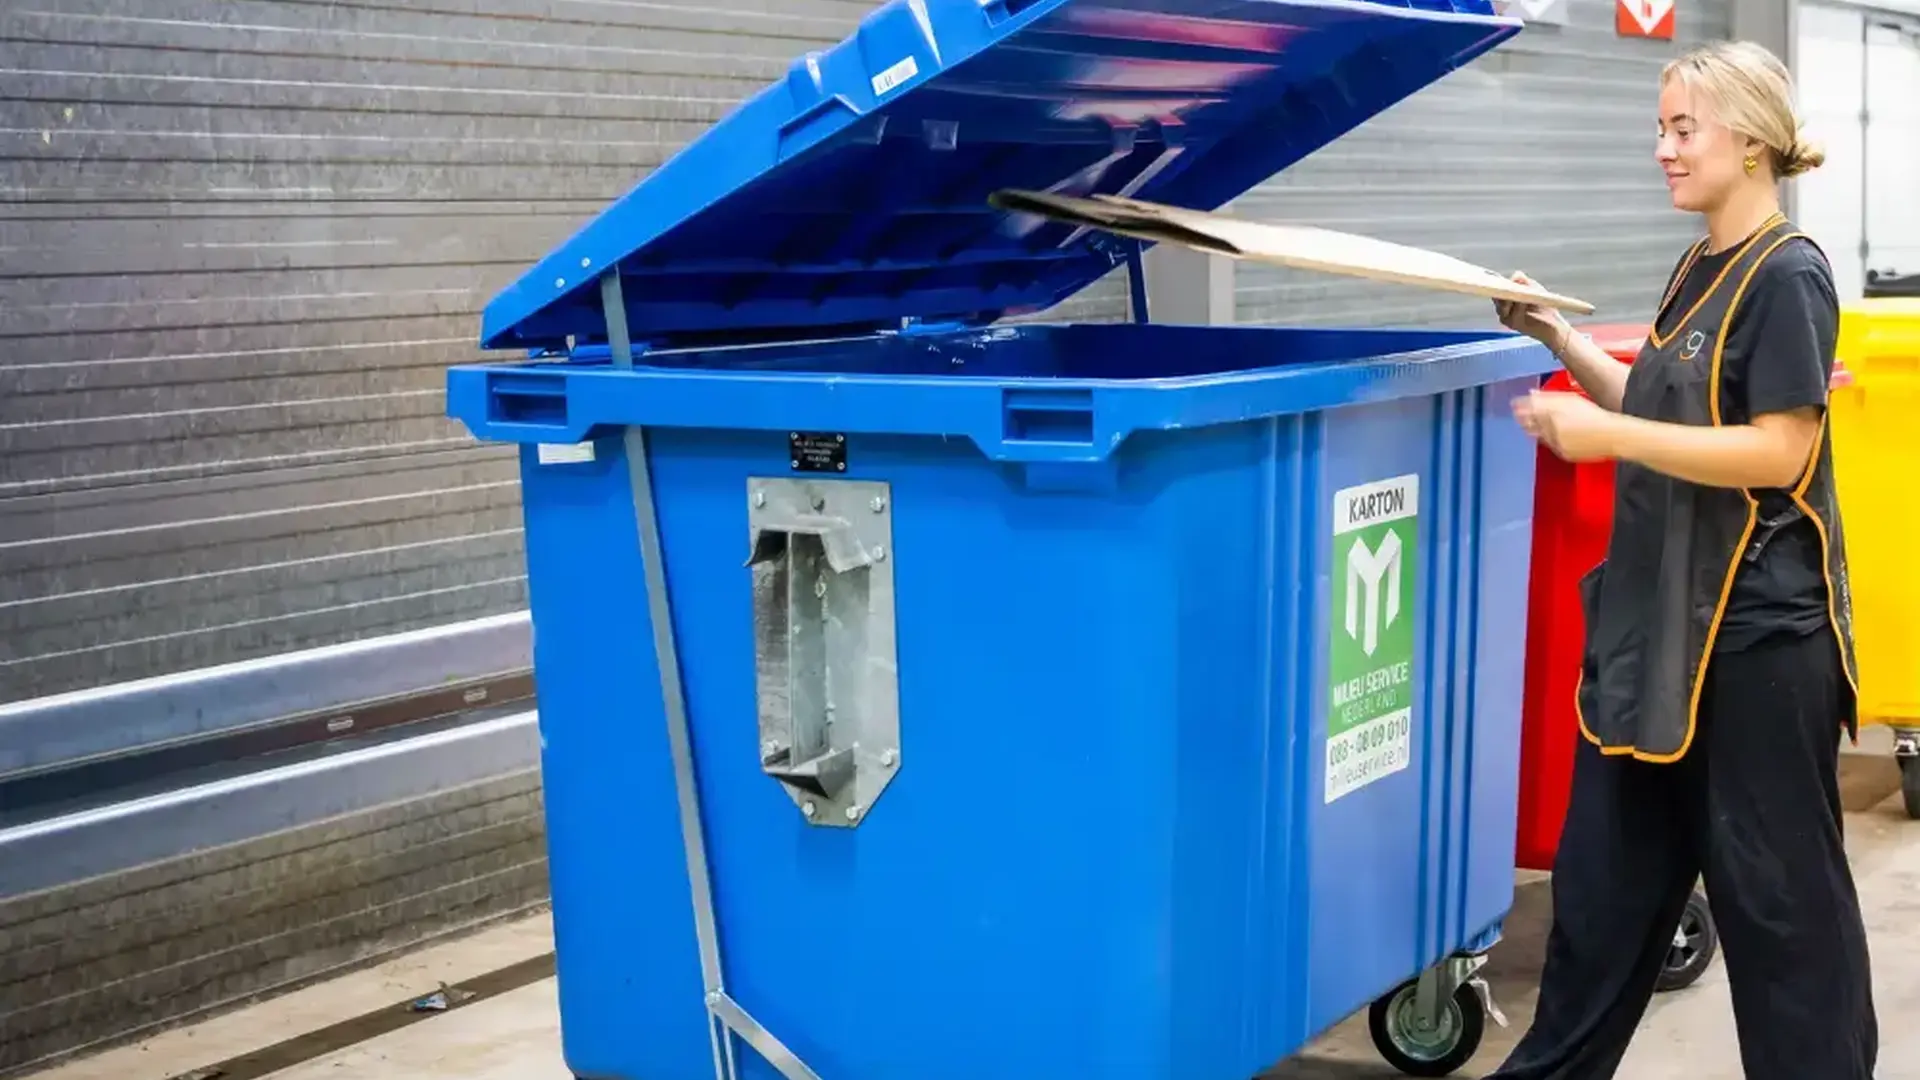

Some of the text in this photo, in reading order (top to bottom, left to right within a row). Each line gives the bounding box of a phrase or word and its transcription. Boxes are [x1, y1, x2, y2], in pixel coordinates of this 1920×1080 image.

[1348, 487, 1405, 524] KARTON
[1366, 661, 1409, 694] SERVICE
[1371, 724, 1385, 748] 09
[1387, 715, 1408, 742] 010
